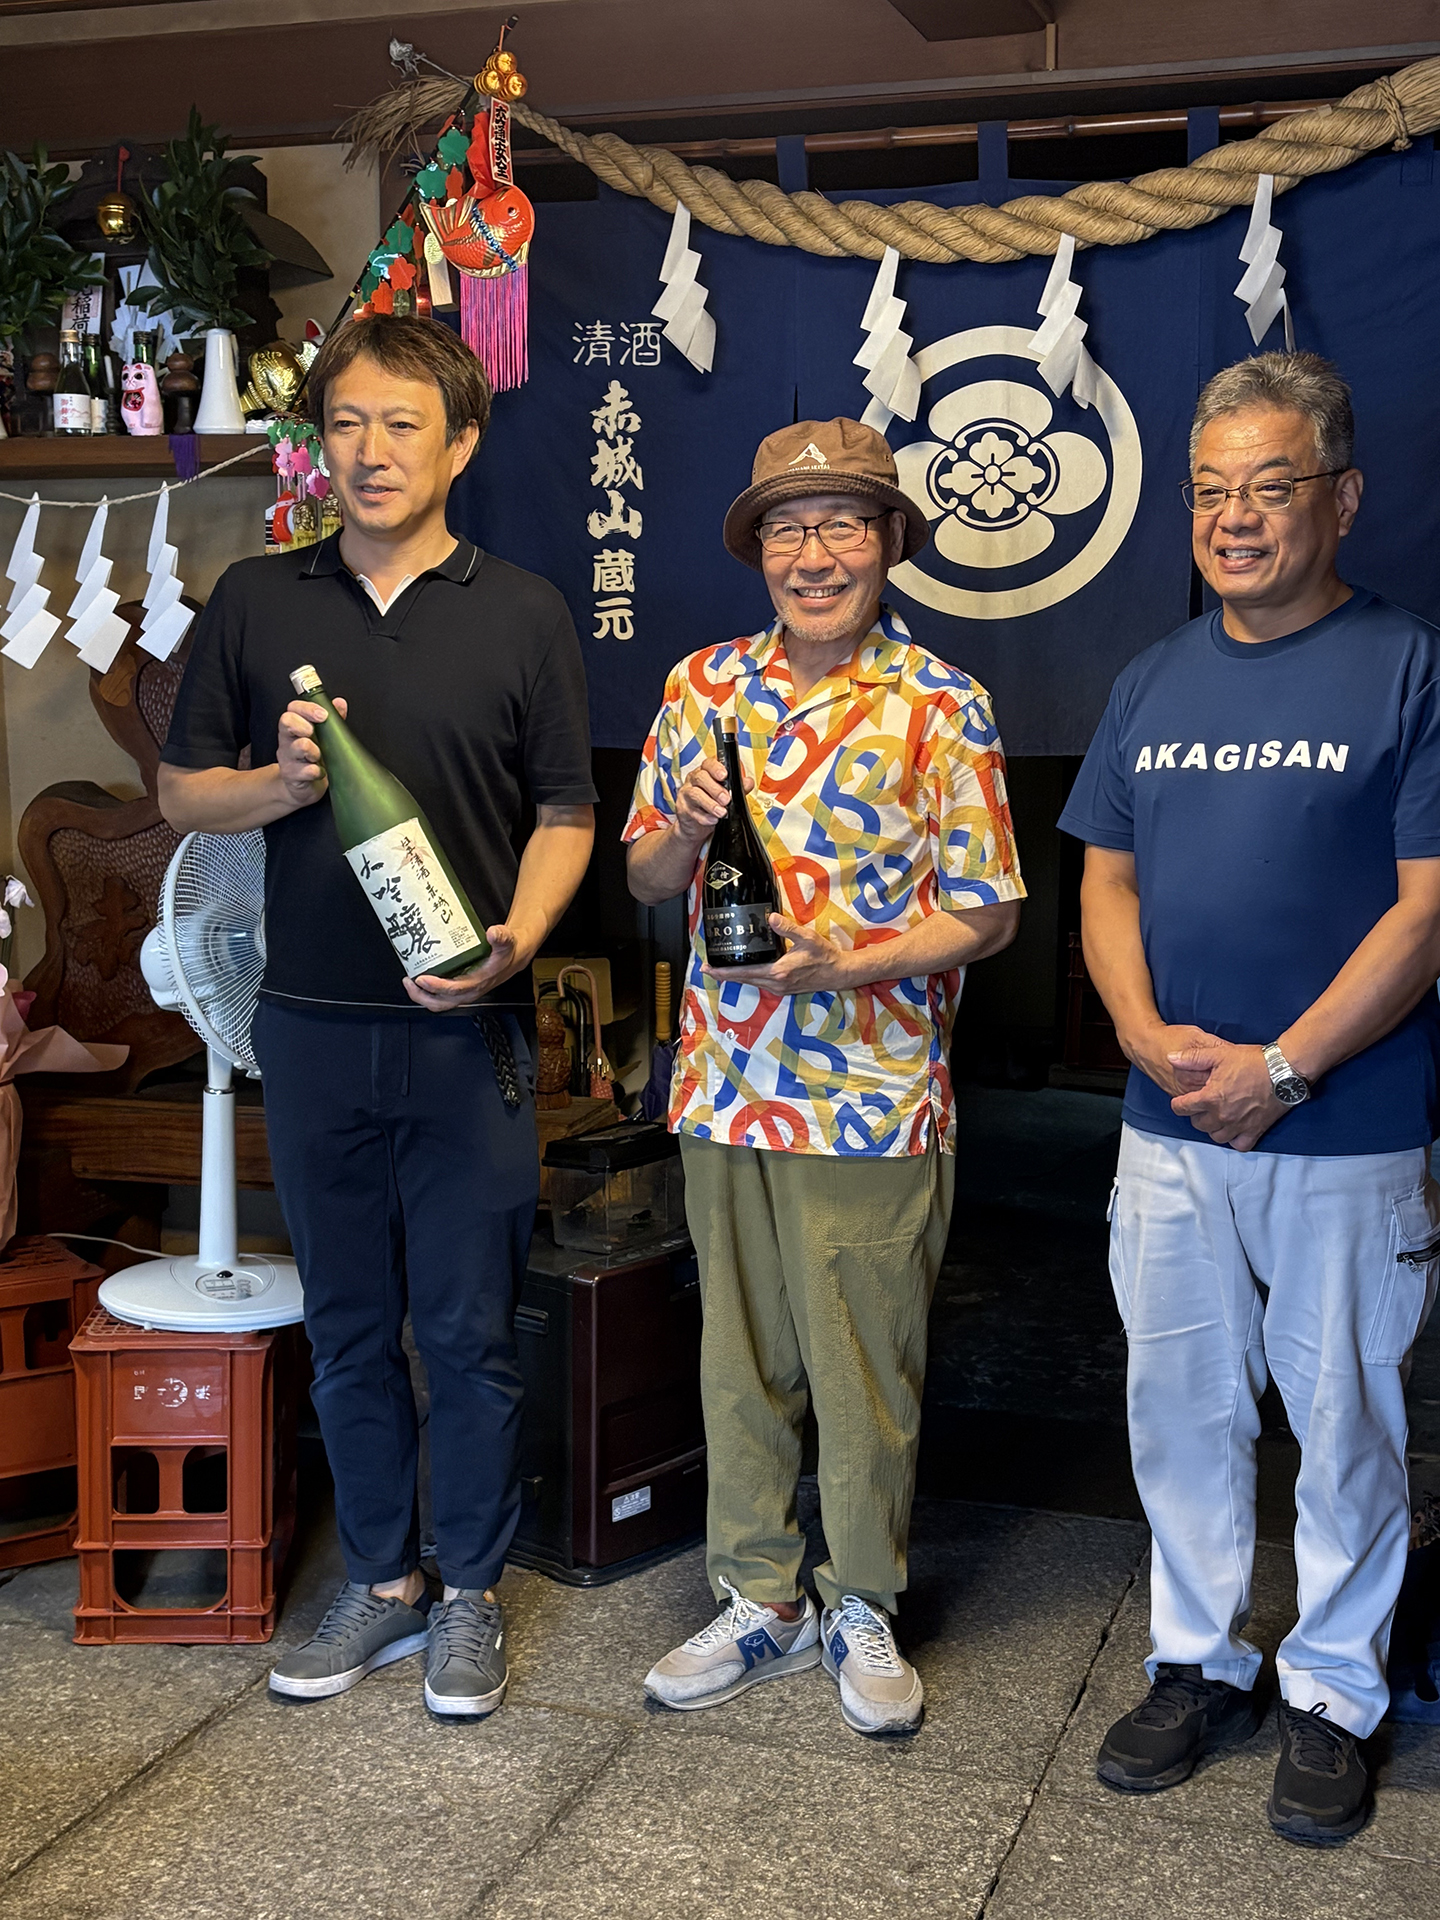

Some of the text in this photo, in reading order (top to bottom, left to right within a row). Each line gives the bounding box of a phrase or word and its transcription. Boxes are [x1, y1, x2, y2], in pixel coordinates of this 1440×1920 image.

[494, 105, 508, 179] 交通安全
[572, 319, 662, 367] 清酒
[1134, 739, 1349, 773] AKAGISAN
